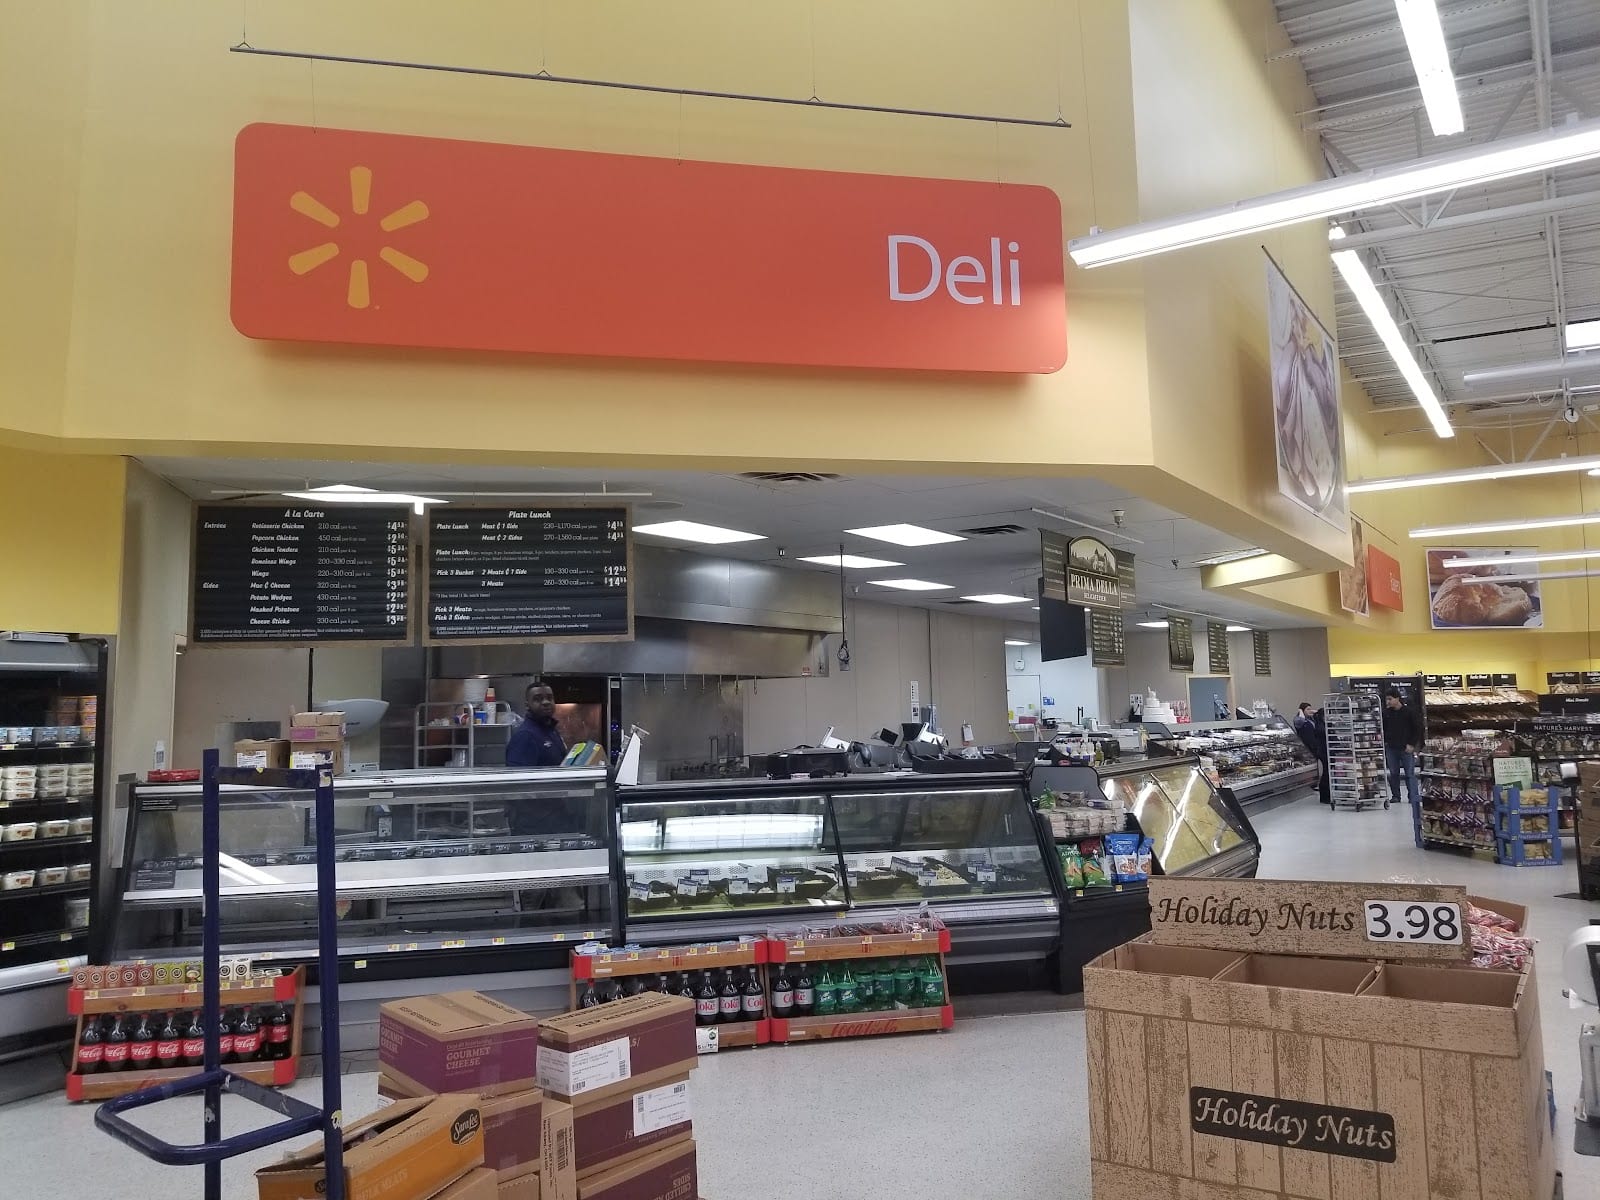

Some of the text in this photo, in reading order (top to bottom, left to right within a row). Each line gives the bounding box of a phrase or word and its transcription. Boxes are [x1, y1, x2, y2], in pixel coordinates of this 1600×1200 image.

[888, 234, 1021, 306] Deli
[292, 510, 302, 518] La
[303, 510, 325, 518] Carte
[508, 511, 551, 519] Plate Lunch
[278, 558, 297, 566] Wings
[251, 570, 270, 578] Wings
[1070, 572, 1095, 592] PRIMA
[1096, 578, 1118, 596] DELLA
[270, 594, 293, 602] Wedges
[1157, 896, 1459, 940] Holiday Nuts 3.98
[446, 1046, 490, 1061] GOURMET
[446, 1057, 481, 1070] CHEESE
[454, 1113, 478, 1140] Sara Lee
[1195, 1097, 1394, 1150] Holiday Nuts
